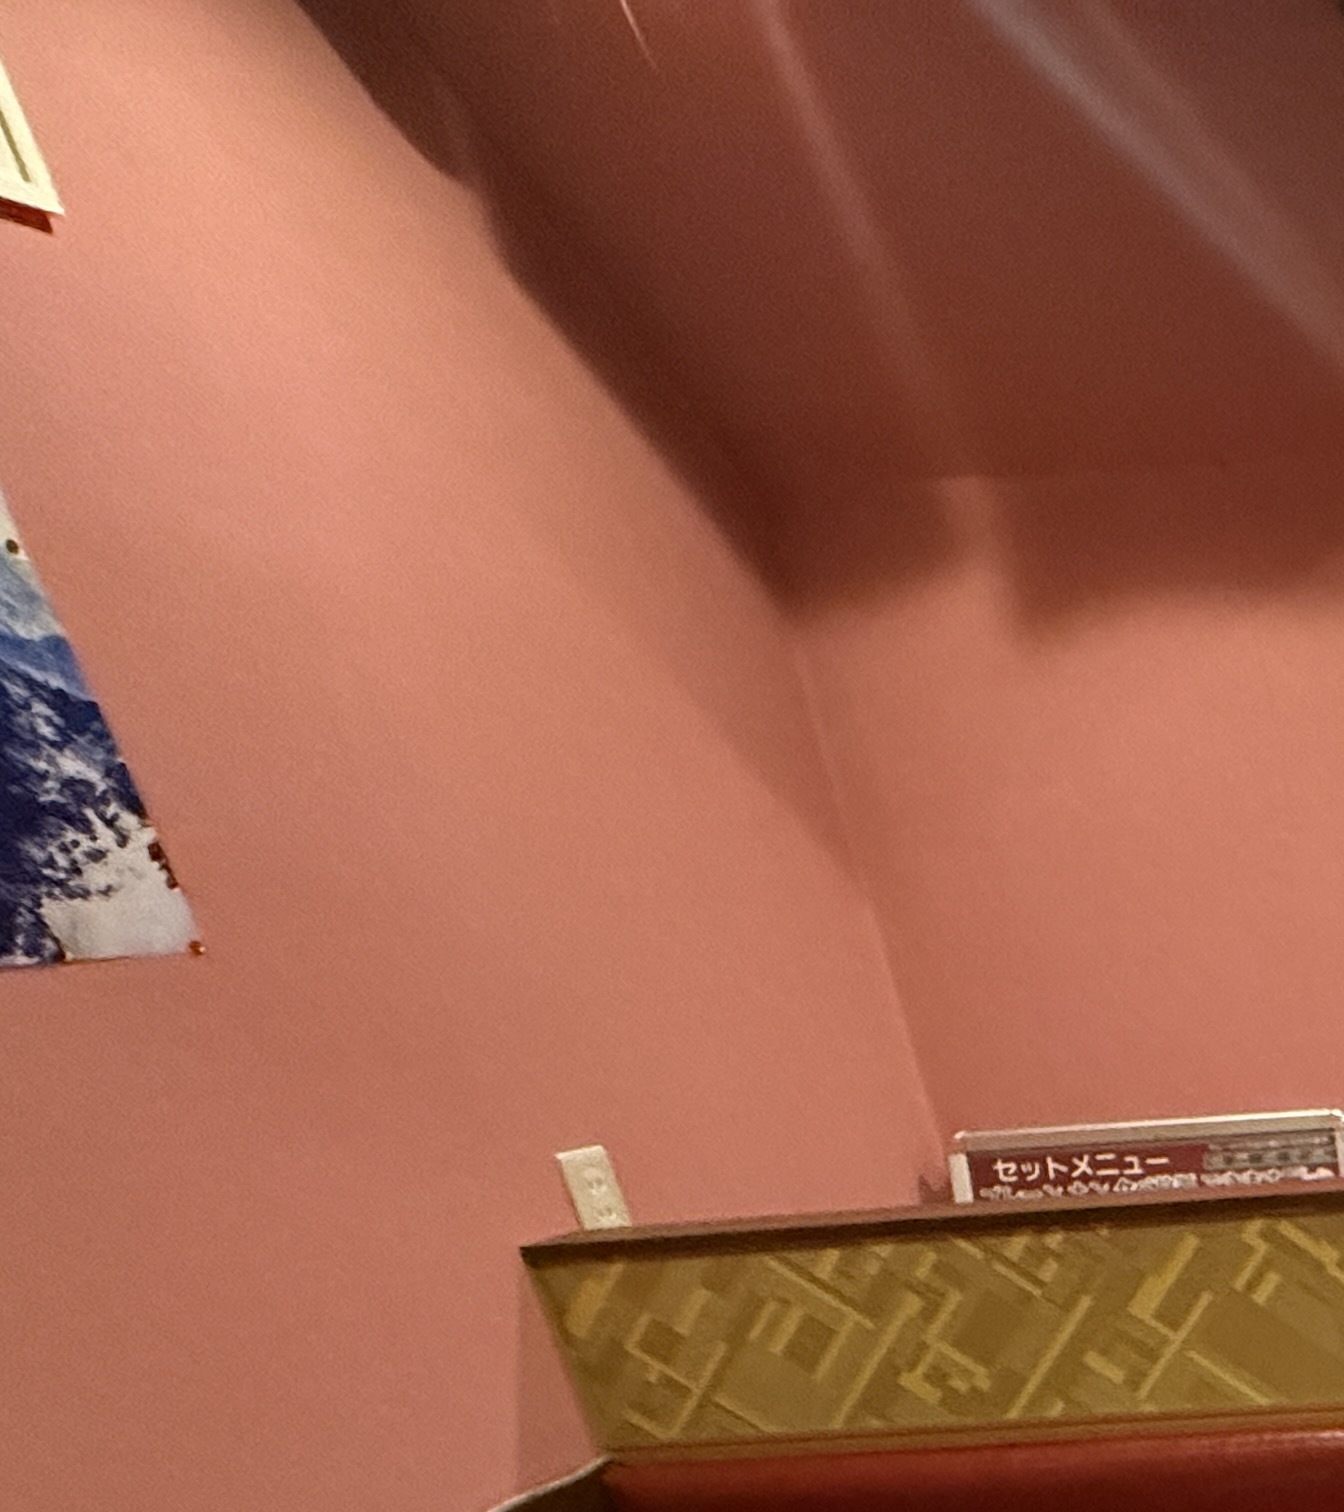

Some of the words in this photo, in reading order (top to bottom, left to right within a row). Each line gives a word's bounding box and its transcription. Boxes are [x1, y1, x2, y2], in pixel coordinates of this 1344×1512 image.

[992, 1152, 1170, 1184] セットメニュー
